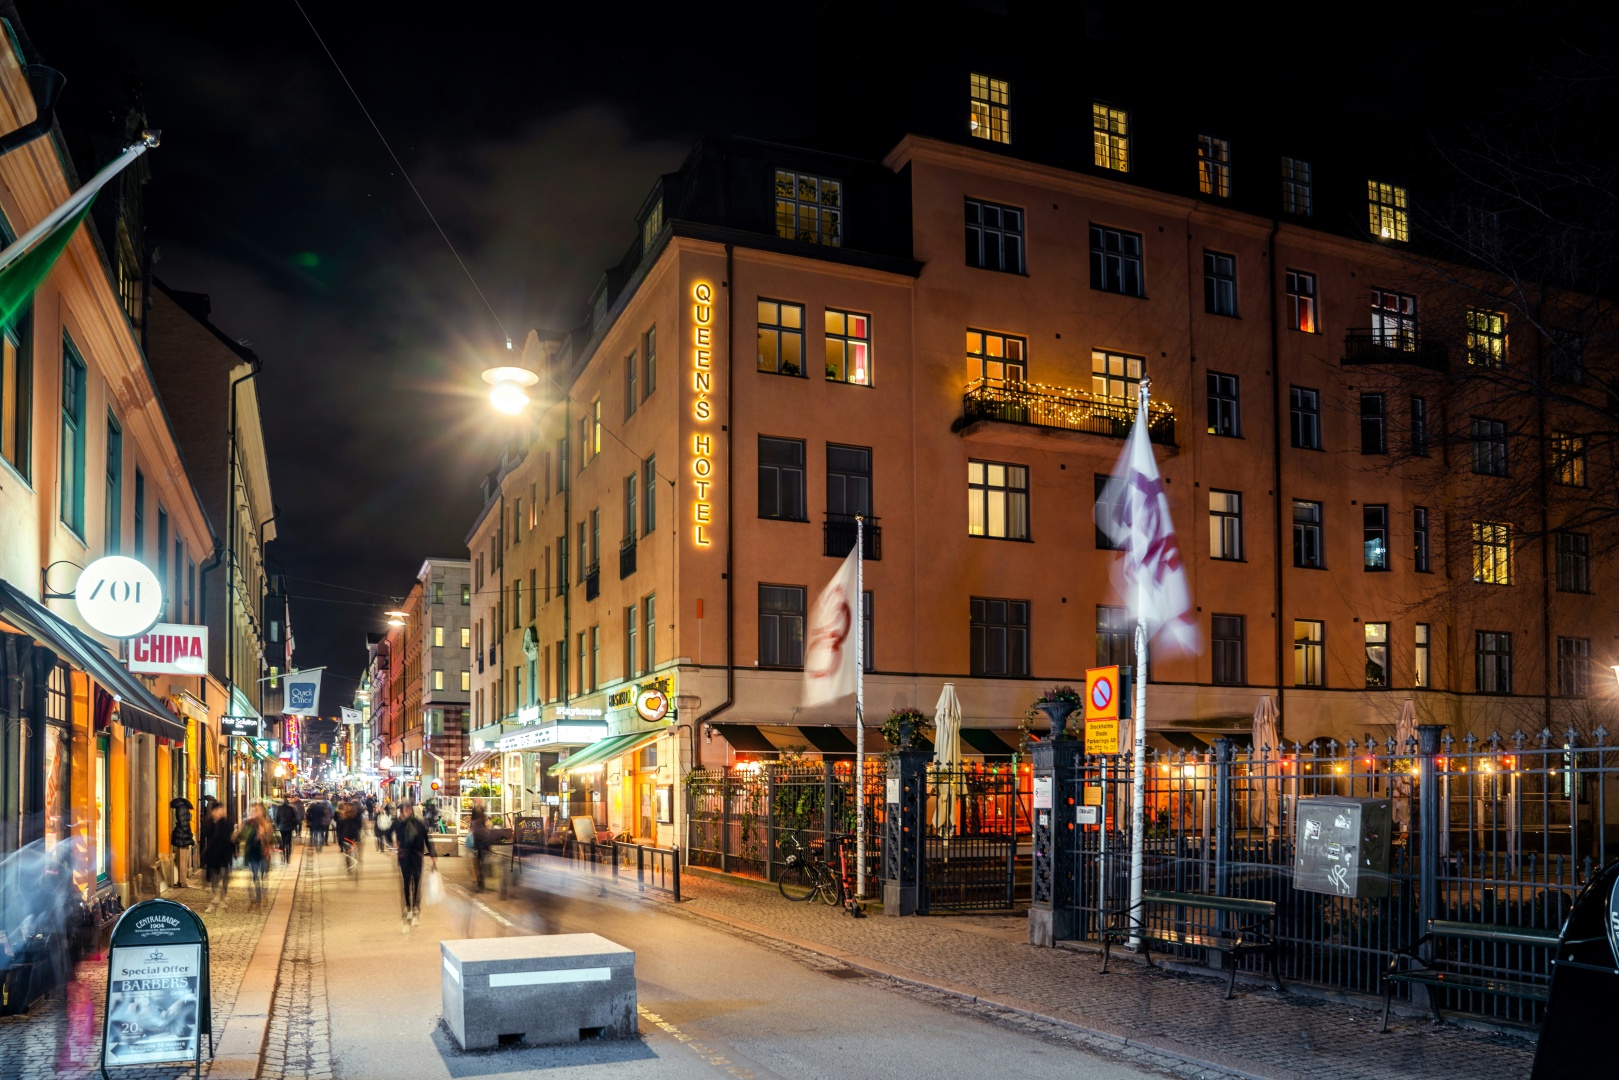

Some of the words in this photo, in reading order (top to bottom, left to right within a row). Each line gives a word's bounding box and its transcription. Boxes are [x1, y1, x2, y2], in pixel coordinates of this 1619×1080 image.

[696, 435, 711, 545] HOTEL
[134, 633, 203, 664] CHINA
[292, 688, 313, 697] Quick
[556, 706, 602, 717] Playhouse
[519, 820, 541, 829] TAPAS
[135, 915, 181, 929] CENTRALBADET
[122, 966, 160, 977] Special
[162, 965, 190, 974] Offer
[122, 977, 189, 991] BARBERS
